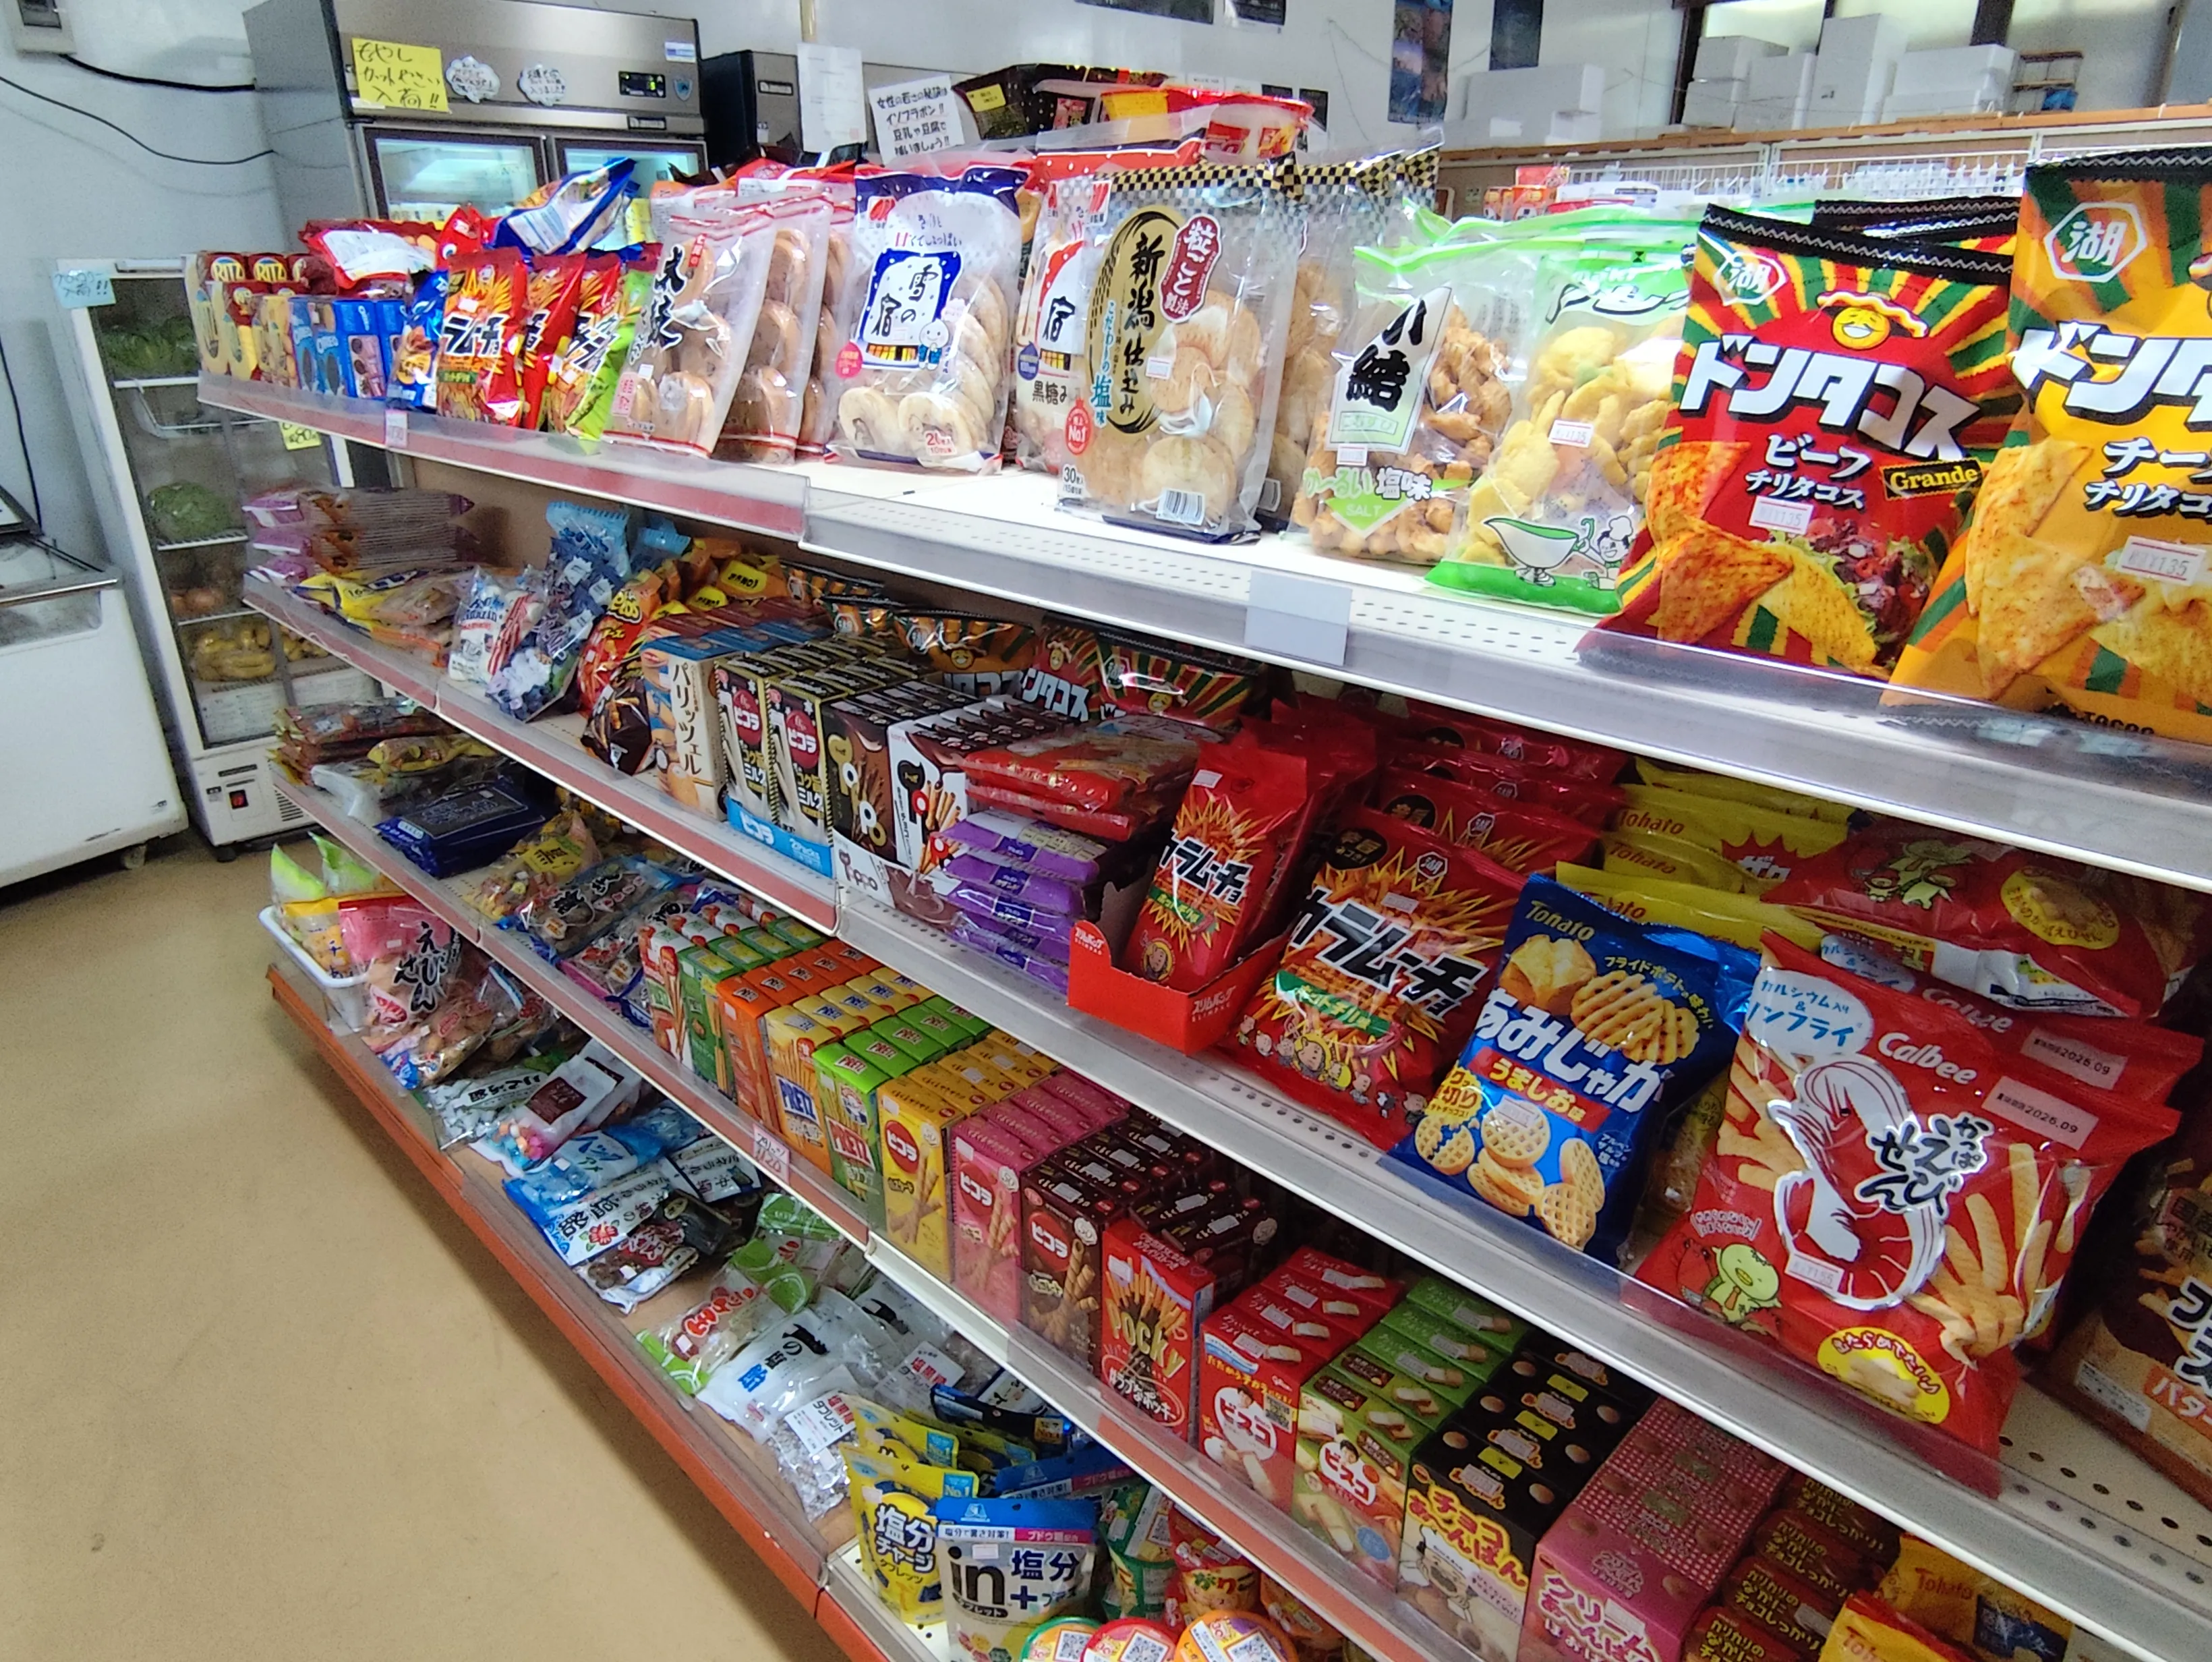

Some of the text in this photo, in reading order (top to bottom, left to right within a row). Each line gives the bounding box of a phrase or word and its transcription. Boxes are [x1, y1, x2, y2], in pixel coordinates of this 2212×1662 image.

[357, 42, 413, 63] もやし
[372, 86, 440, 109] 入荷!!
[2061, 219, 2128, 267] 湖
[213, 263, 245, 282] RITZ
[256, 263, 287, 282] RITZ
[871, 263, 939, 337] 雪の宿
[1119, 232, 1165, 417] 新潟仕込み
[1679, 333, 1981, 461] ドンタコス
[1764, 433, 1873, 479] ビーフ
[2103, 436, 2212, 483] チー
[1745, 469, 1866, 513] チリタコス
[1890, 465, 1980, 492] Grande
[1345, 504, 1382, 517] SALT
[2084, 479, 2212, 522] チリタコ
[1021, 668, 1091, 722] ンタコス
[673, 662, 703, 776] パリッツェル
[787, 728, 817, 753] ピコラ
[1608, 896, 1647, 919] ato
[1288, 884, 1490, 1021] カラムーチョ
[1762, 979, 1850, 1014] カルシウム入り
[839, 1056, 867, 1073] PRETZ
[1878, 1032, 1977, 1085] Calbee
[1488, 1056, 1587, 1122] うましお味
[887, 1128, 919, 1163] ピコラ
[960, 1170, 993, 1207] ピコラ
[1030, 1221, 1069, 1259] ピコラ
[812, 1400, 846, 1433] タブレット
[1219, 1397, 1273, 1448] ビスコ
[1325, 1448, 1370, 1503] ビスコ
[875, 1503, 935, 1553] 塩分
[1432, 1490, 1506, 1549] チョコ
[876, 1535, 935, 1573] チャージ
[1011, 1549, 1080, 1582] 塩分
[948, 1546, 1006, 1606] in
